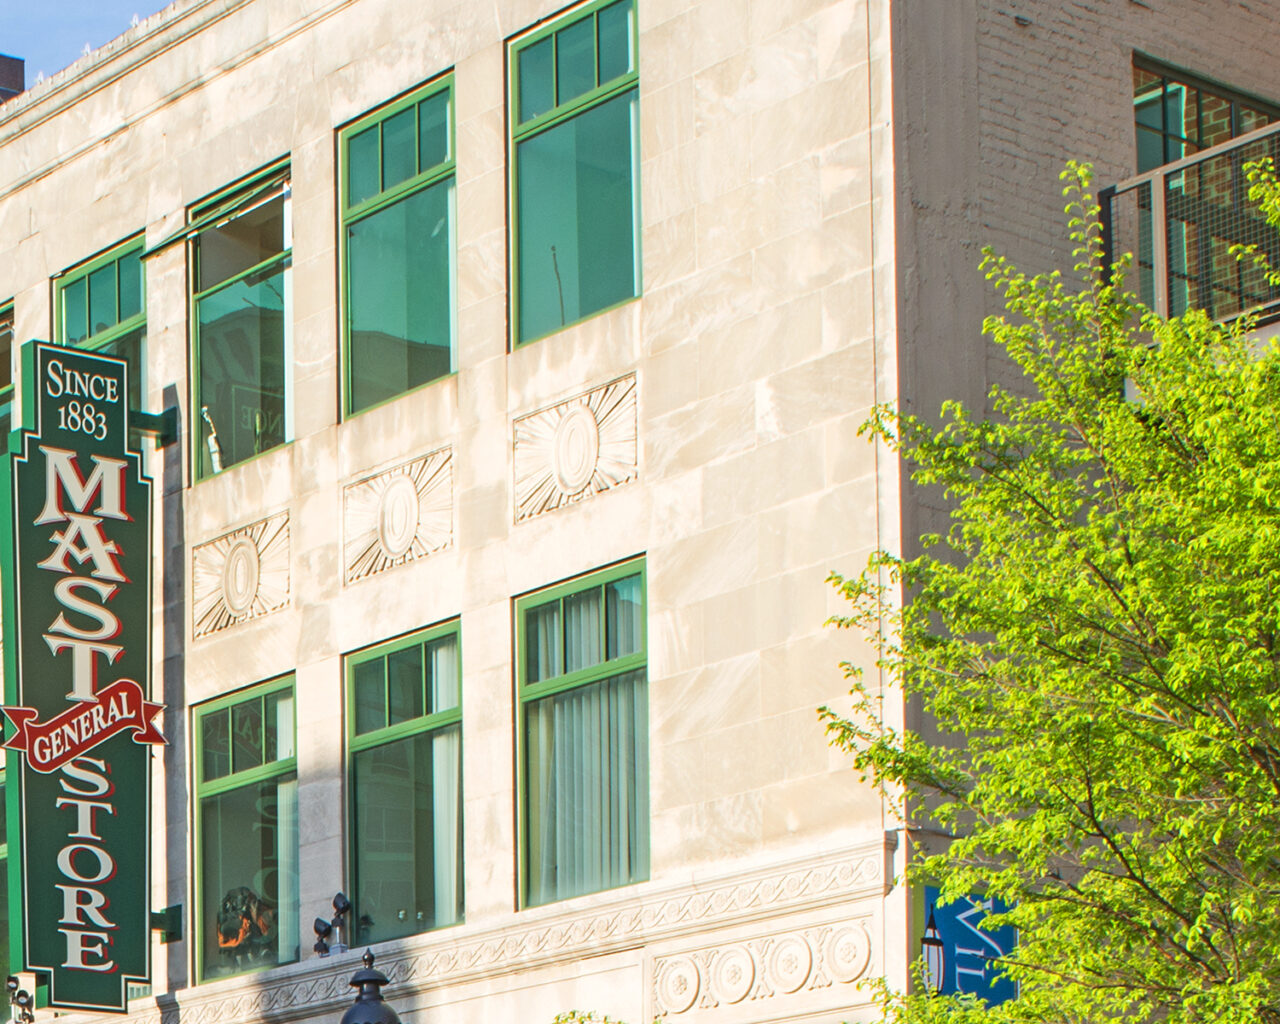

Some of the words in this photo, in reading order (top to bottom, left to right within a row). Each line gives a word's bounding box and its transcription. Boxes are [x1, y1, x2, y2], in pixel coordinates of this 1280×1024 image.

[46, 360, 119, 403] SINCE
[58, 401, 108, 441] 1883
[33, 445, 135, 703] MAST
[33, 692, 137, 764] GENERAL
[54, 756, 120, 974] STORE
